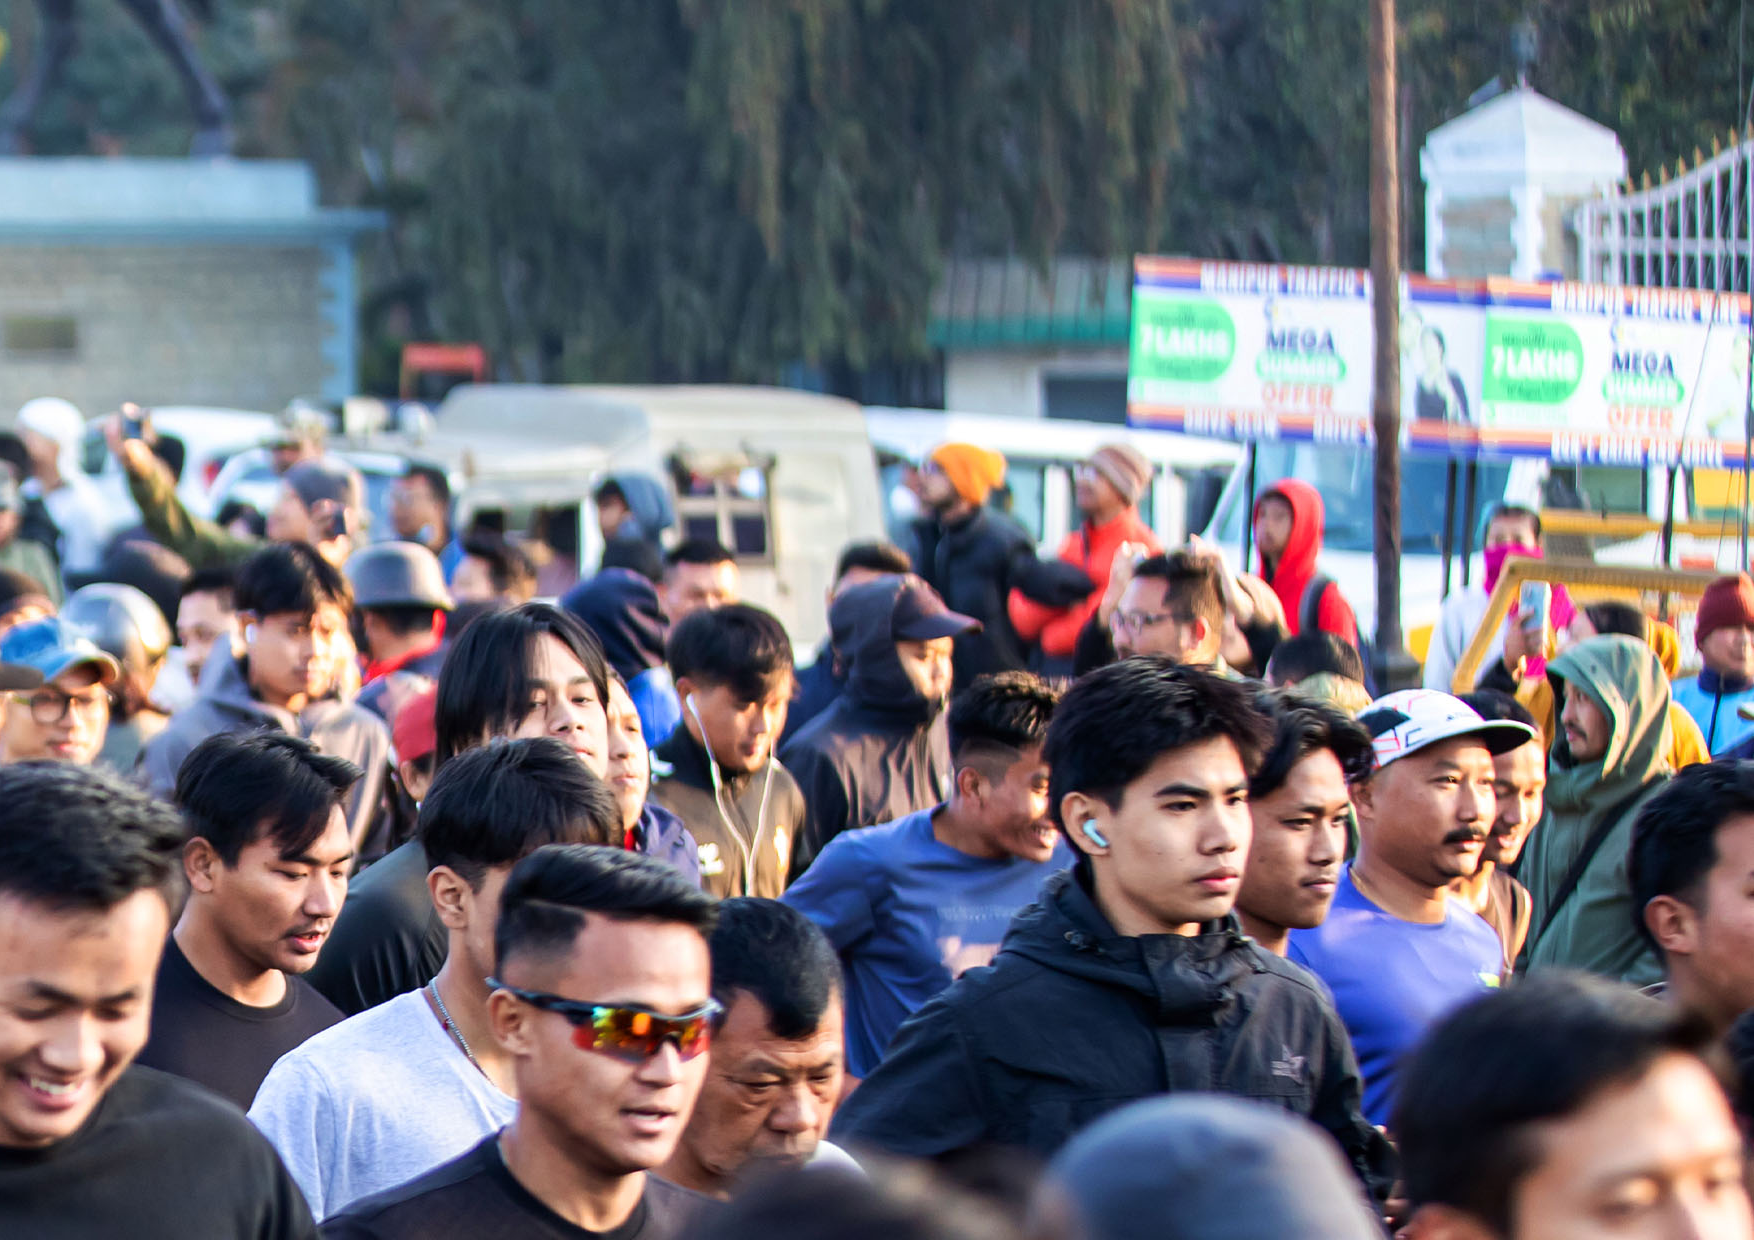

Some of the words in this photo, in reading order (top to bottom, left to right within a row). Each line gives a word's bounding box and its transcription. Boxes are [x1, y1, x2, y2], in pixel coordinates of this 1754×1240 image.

[1201, 261, 1279, 295] MANIPUR
[1286, 264, 1356, 297] TRAFFIC
[1551, 280, 1625, 315] MANIPUR
[1632, 284, 1693, 321] TRAFFIC
[1141, 323, 1153, 354] 7
[1155, 328, 1231, 359] LAKHS
[1265, 328, 1335, 354] MEGA
[1492, 345, 1505, 378] 7
[1507, 348, 1578, 380] LAKHS
[1611, 350, 1674, 376] MEGA
[1261, 382, 1334, 411] OFFER
[1605, 377, 1677, 403] SUMMER
[1607, 403, 1673, 432] OFFER
